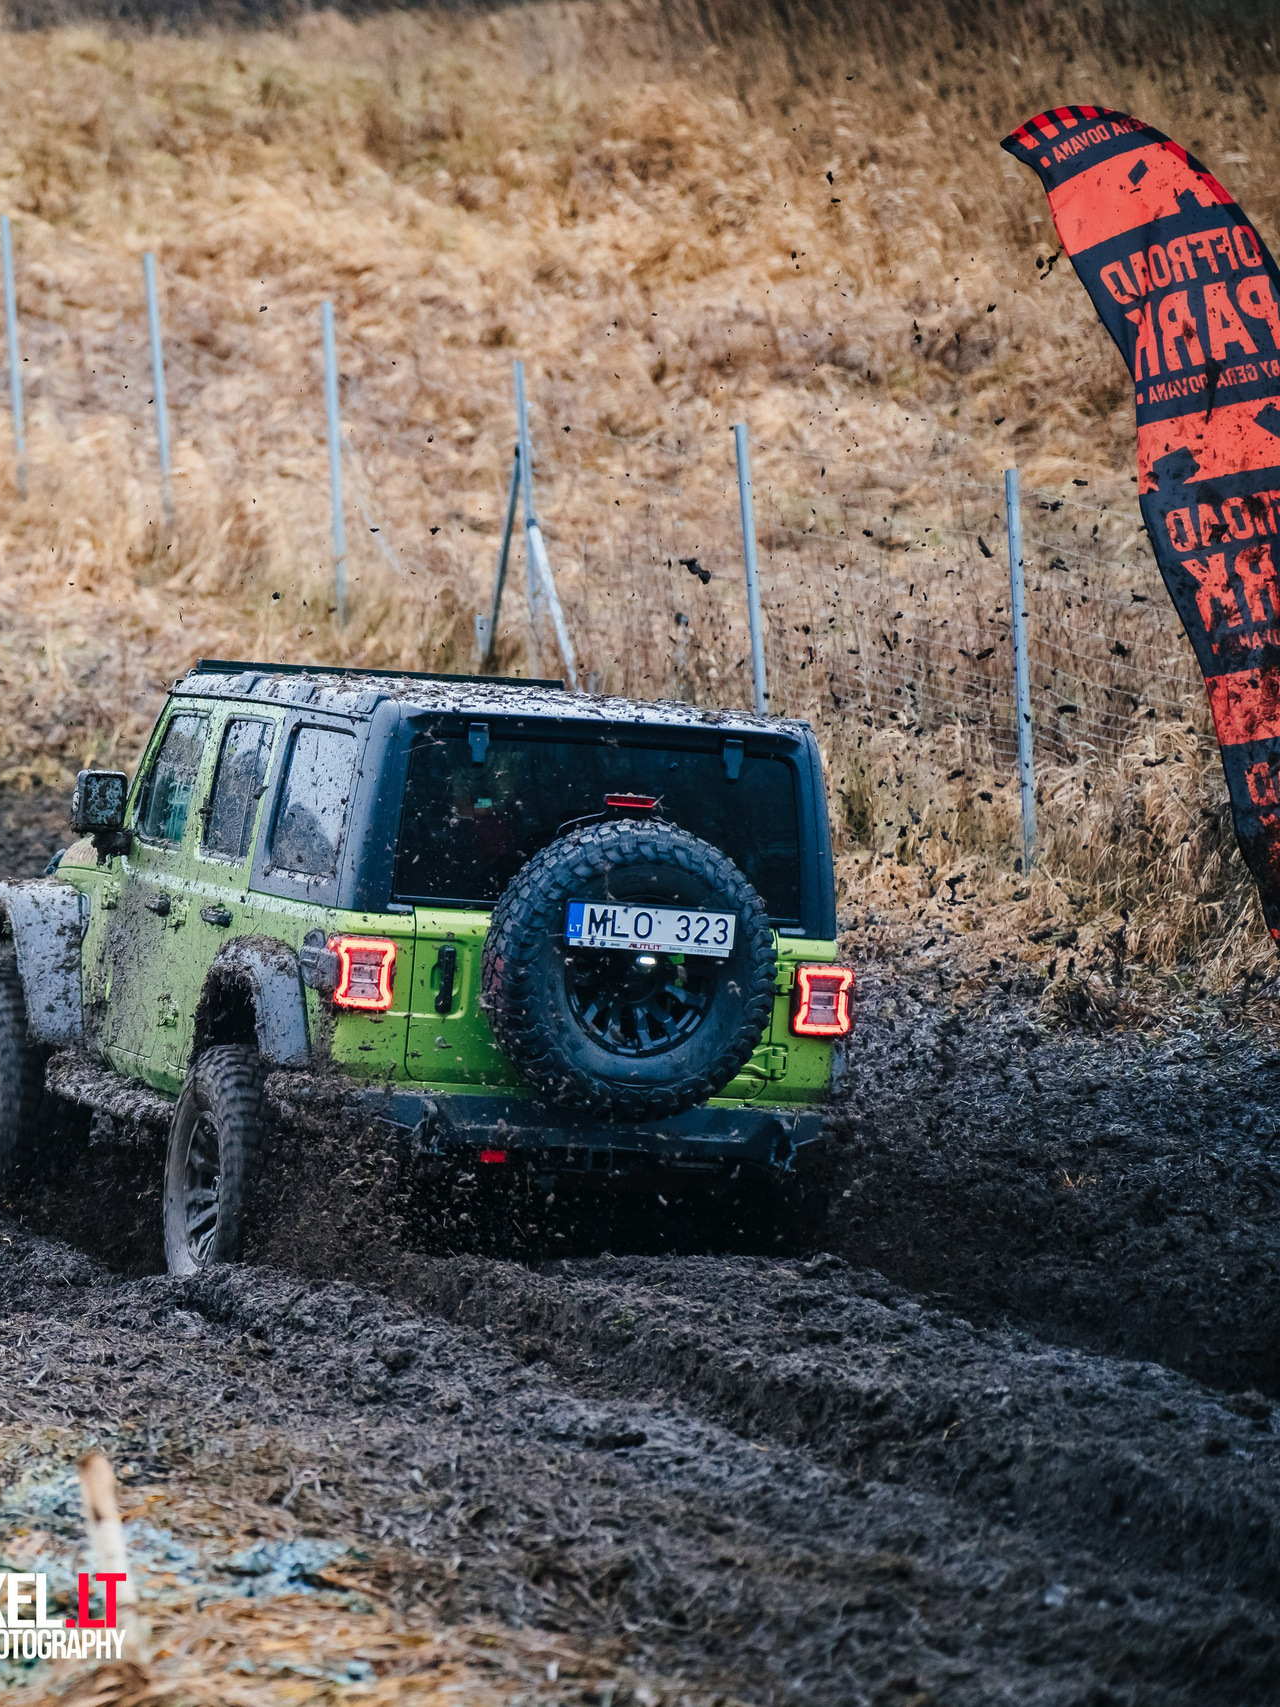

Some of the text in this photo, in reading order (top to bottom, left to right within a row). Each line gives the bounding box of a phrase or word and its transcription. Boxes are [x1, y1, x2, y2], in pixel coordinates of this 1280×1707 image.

[569, 923, 581, 933] LT
[588, 907, 729, 945] MLO 323
